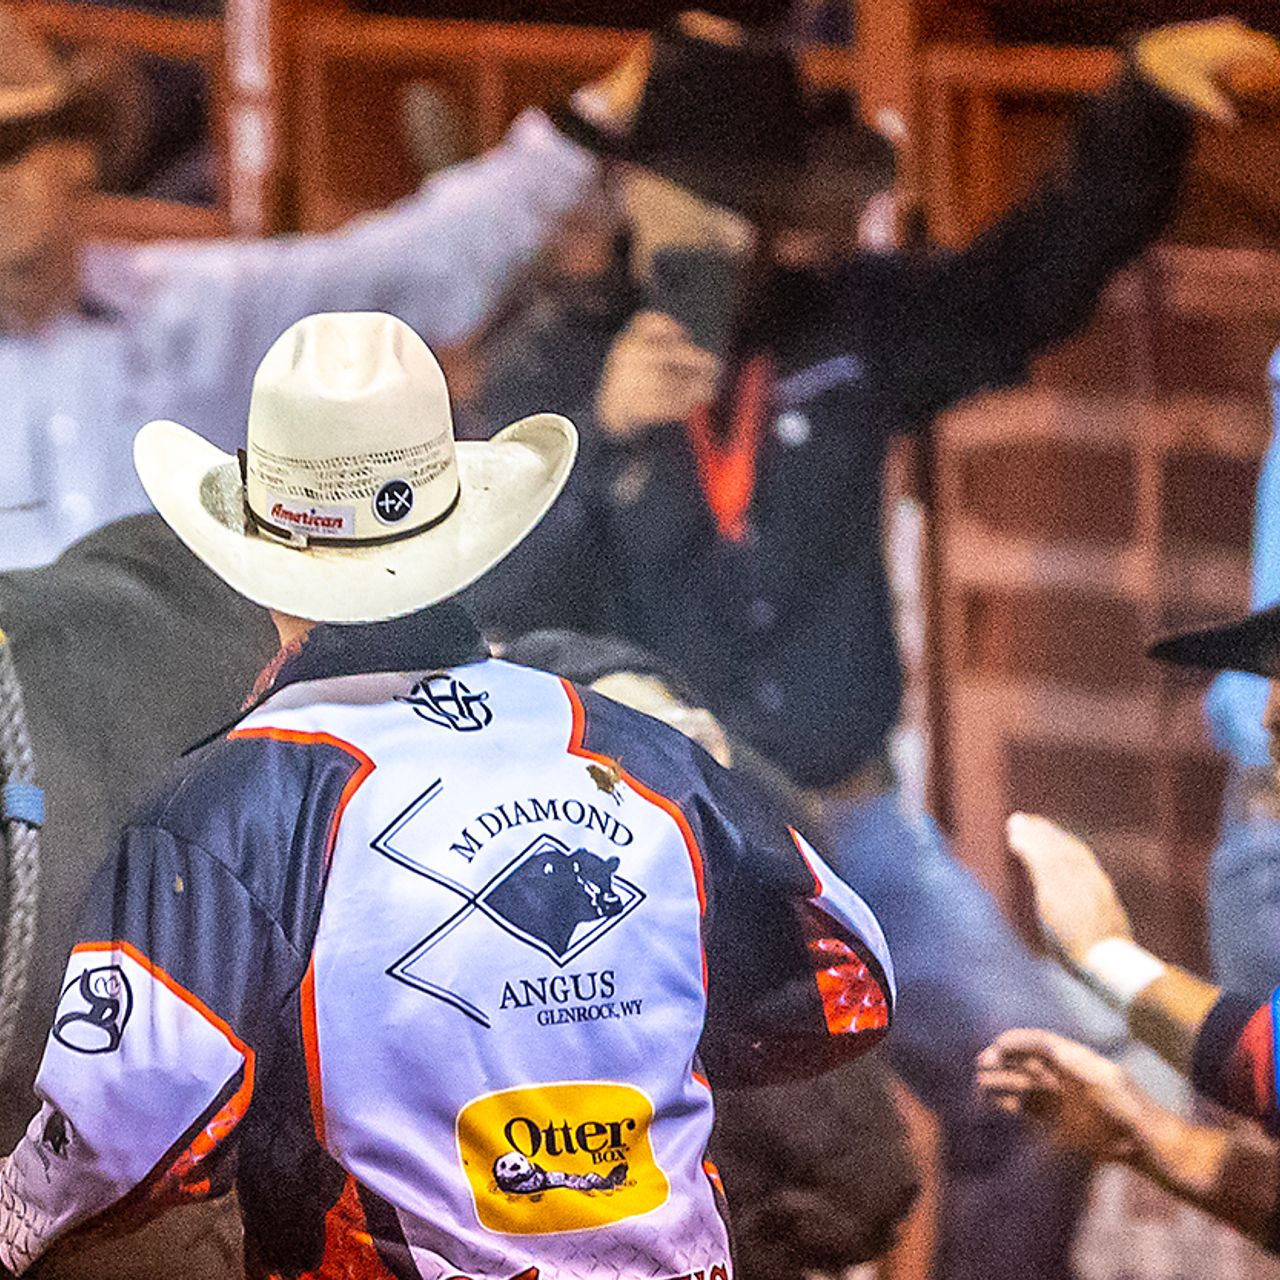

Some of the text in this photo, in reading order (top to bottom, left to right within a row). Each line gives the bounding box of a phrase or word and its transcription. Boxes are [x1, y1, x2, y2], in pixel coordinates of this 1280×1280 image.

[449, 798, 634, 863] M DIAMOND
[499, 970, 615, 1009] ANGUS
[536, 999, 642, 1026] GLENROCK, WY
[504, 1116, 636, 1157] Otter
